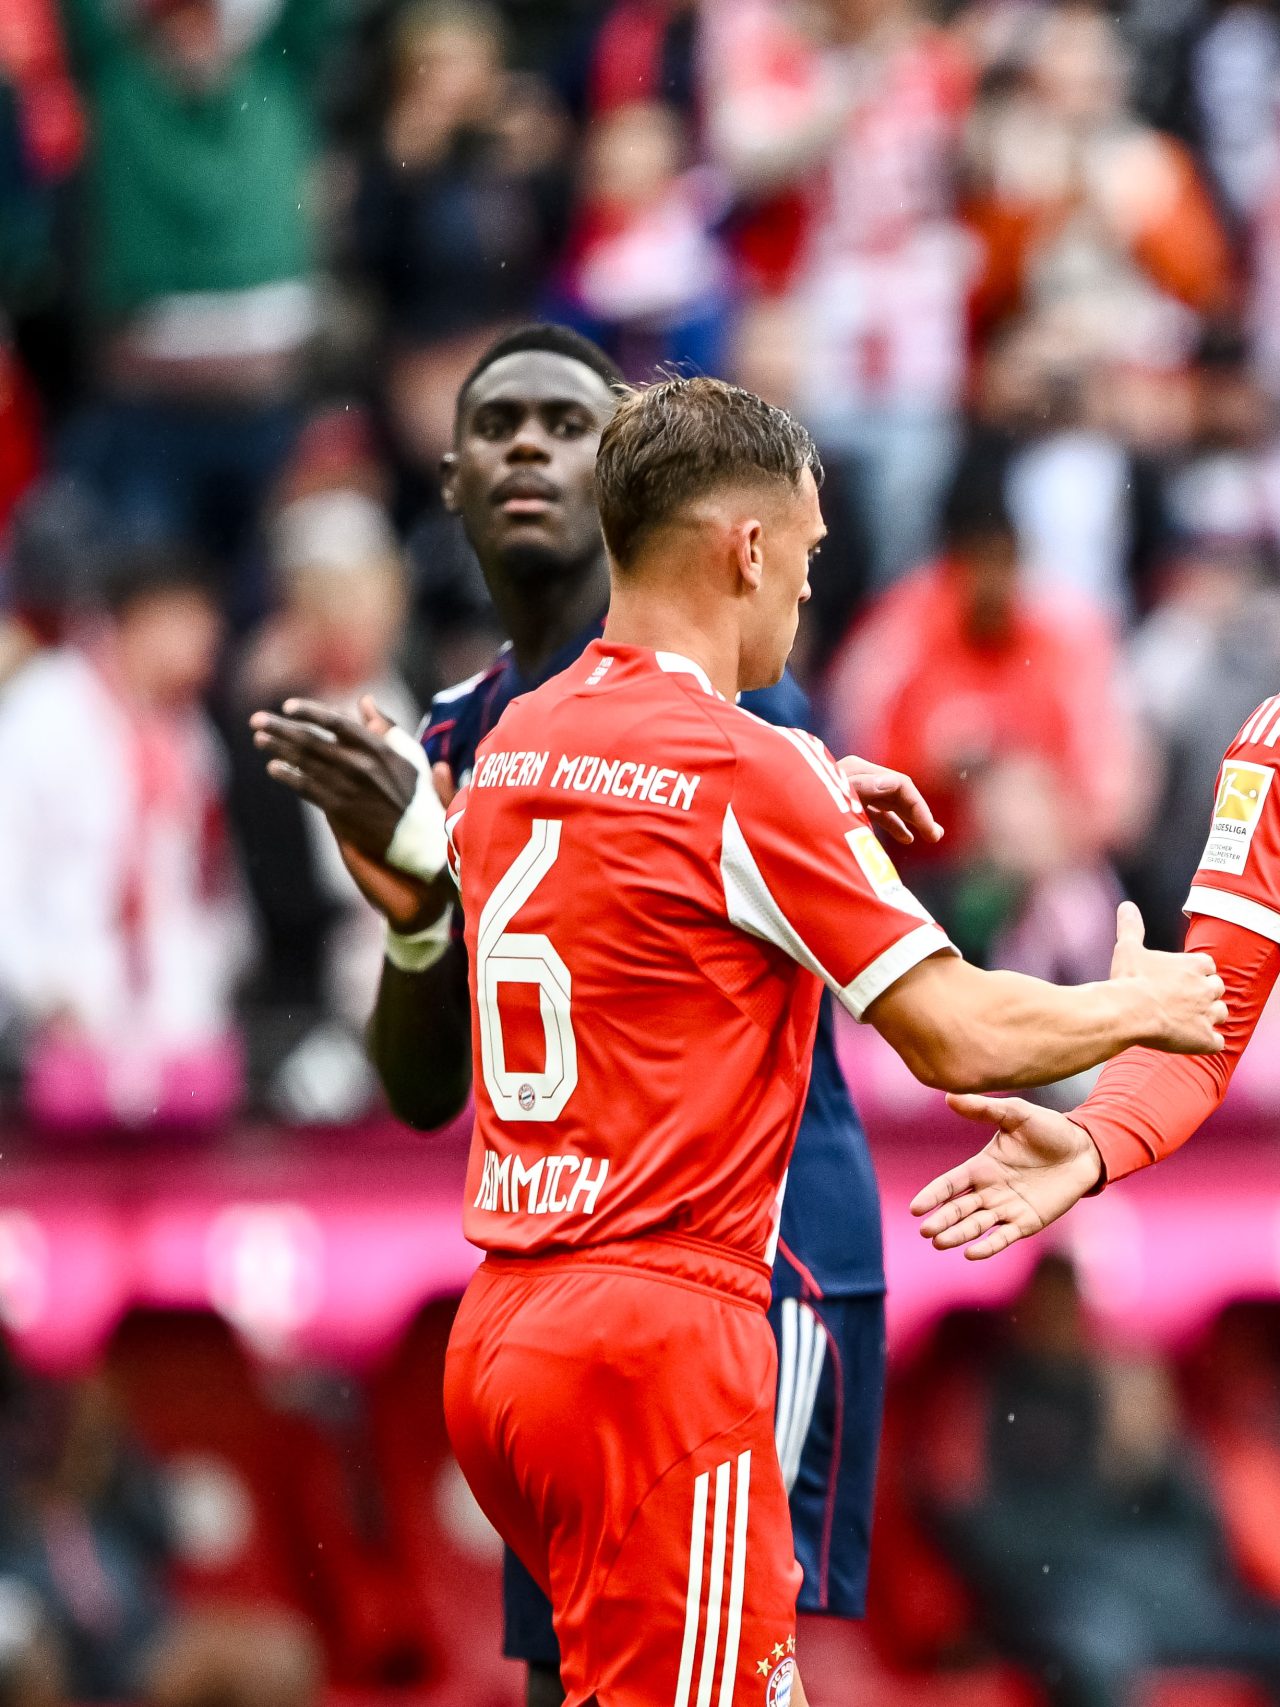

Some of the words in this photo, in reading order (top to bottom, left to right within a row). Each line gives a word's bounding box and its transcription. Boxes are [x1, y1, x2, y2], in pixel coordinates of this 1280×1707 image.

[478, 751, 549, 788] BAYERN
[550, 754, 701, 811] MÜNCHEN
[1213, 823, 1247, 836] NDESLIGA
[476, 818, 579, 1122] 6
